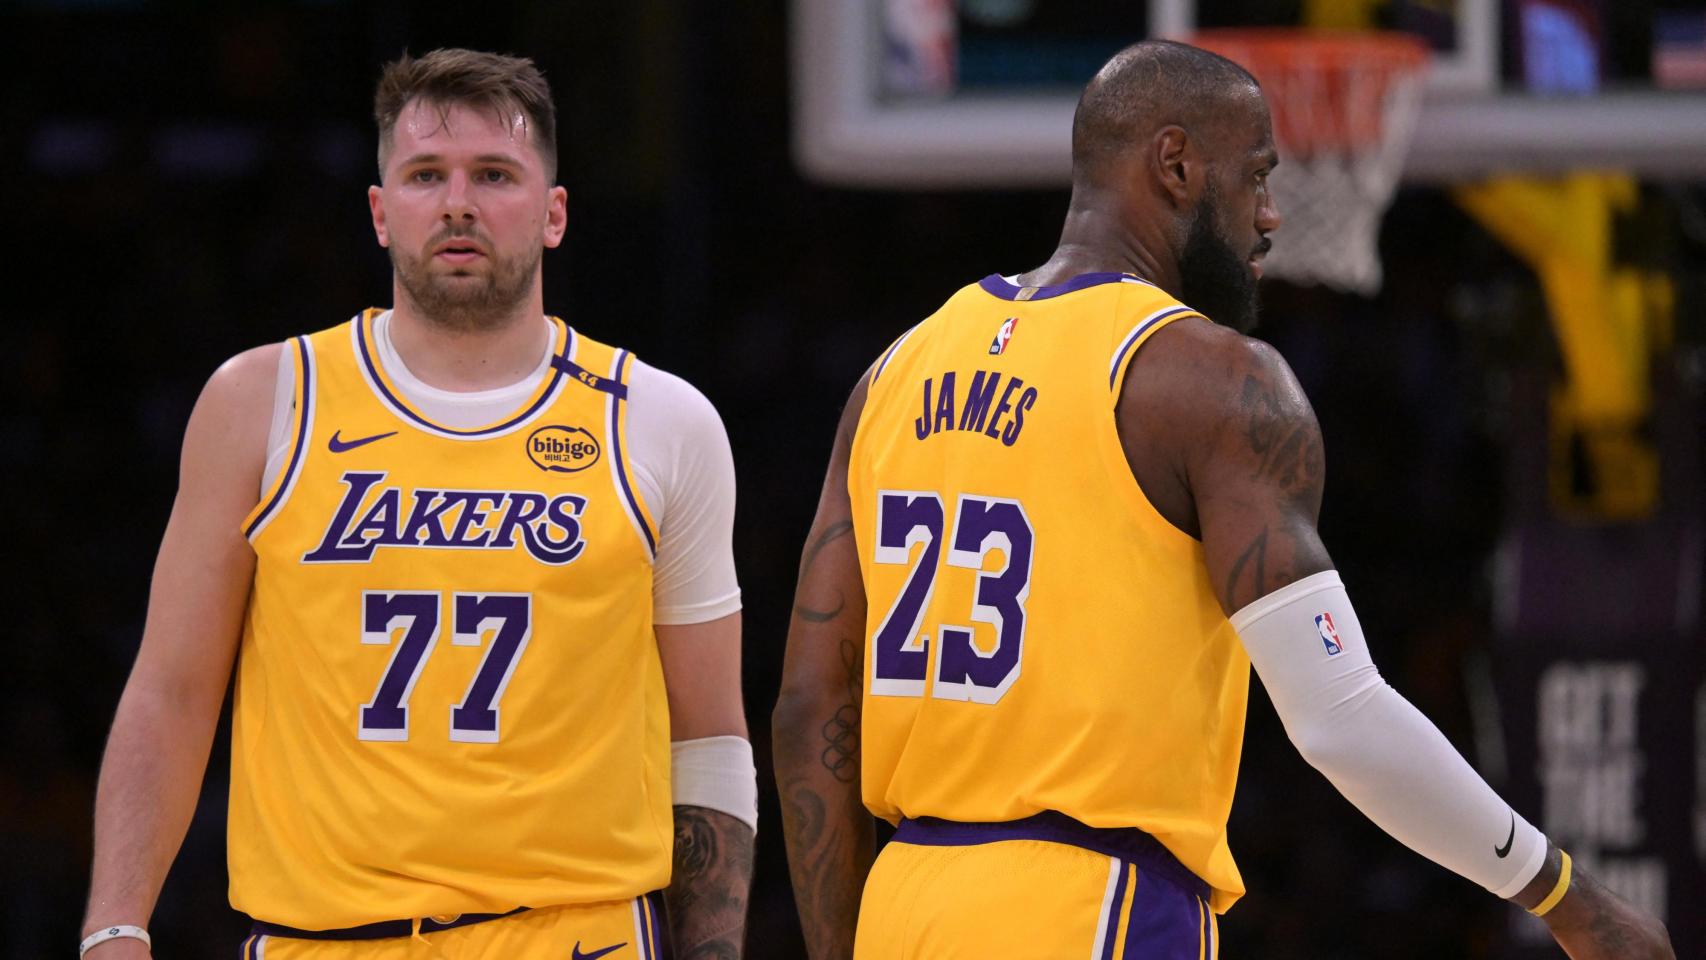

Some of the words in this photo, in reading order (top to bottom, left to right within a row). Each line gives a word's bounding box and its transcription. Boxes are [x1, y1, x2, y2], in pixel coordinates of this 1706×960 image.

[578, 371, 598, 387] 44
[915, 370, 1037, 447] JAMES
[533, 437, 596, 459] bibigo
[544, 454, 570, 462] 비비고
[300, 471, 589, 566] LAKERS
[870, 489, 1035, 705] 23
[358, 589, 533, 743] 77
